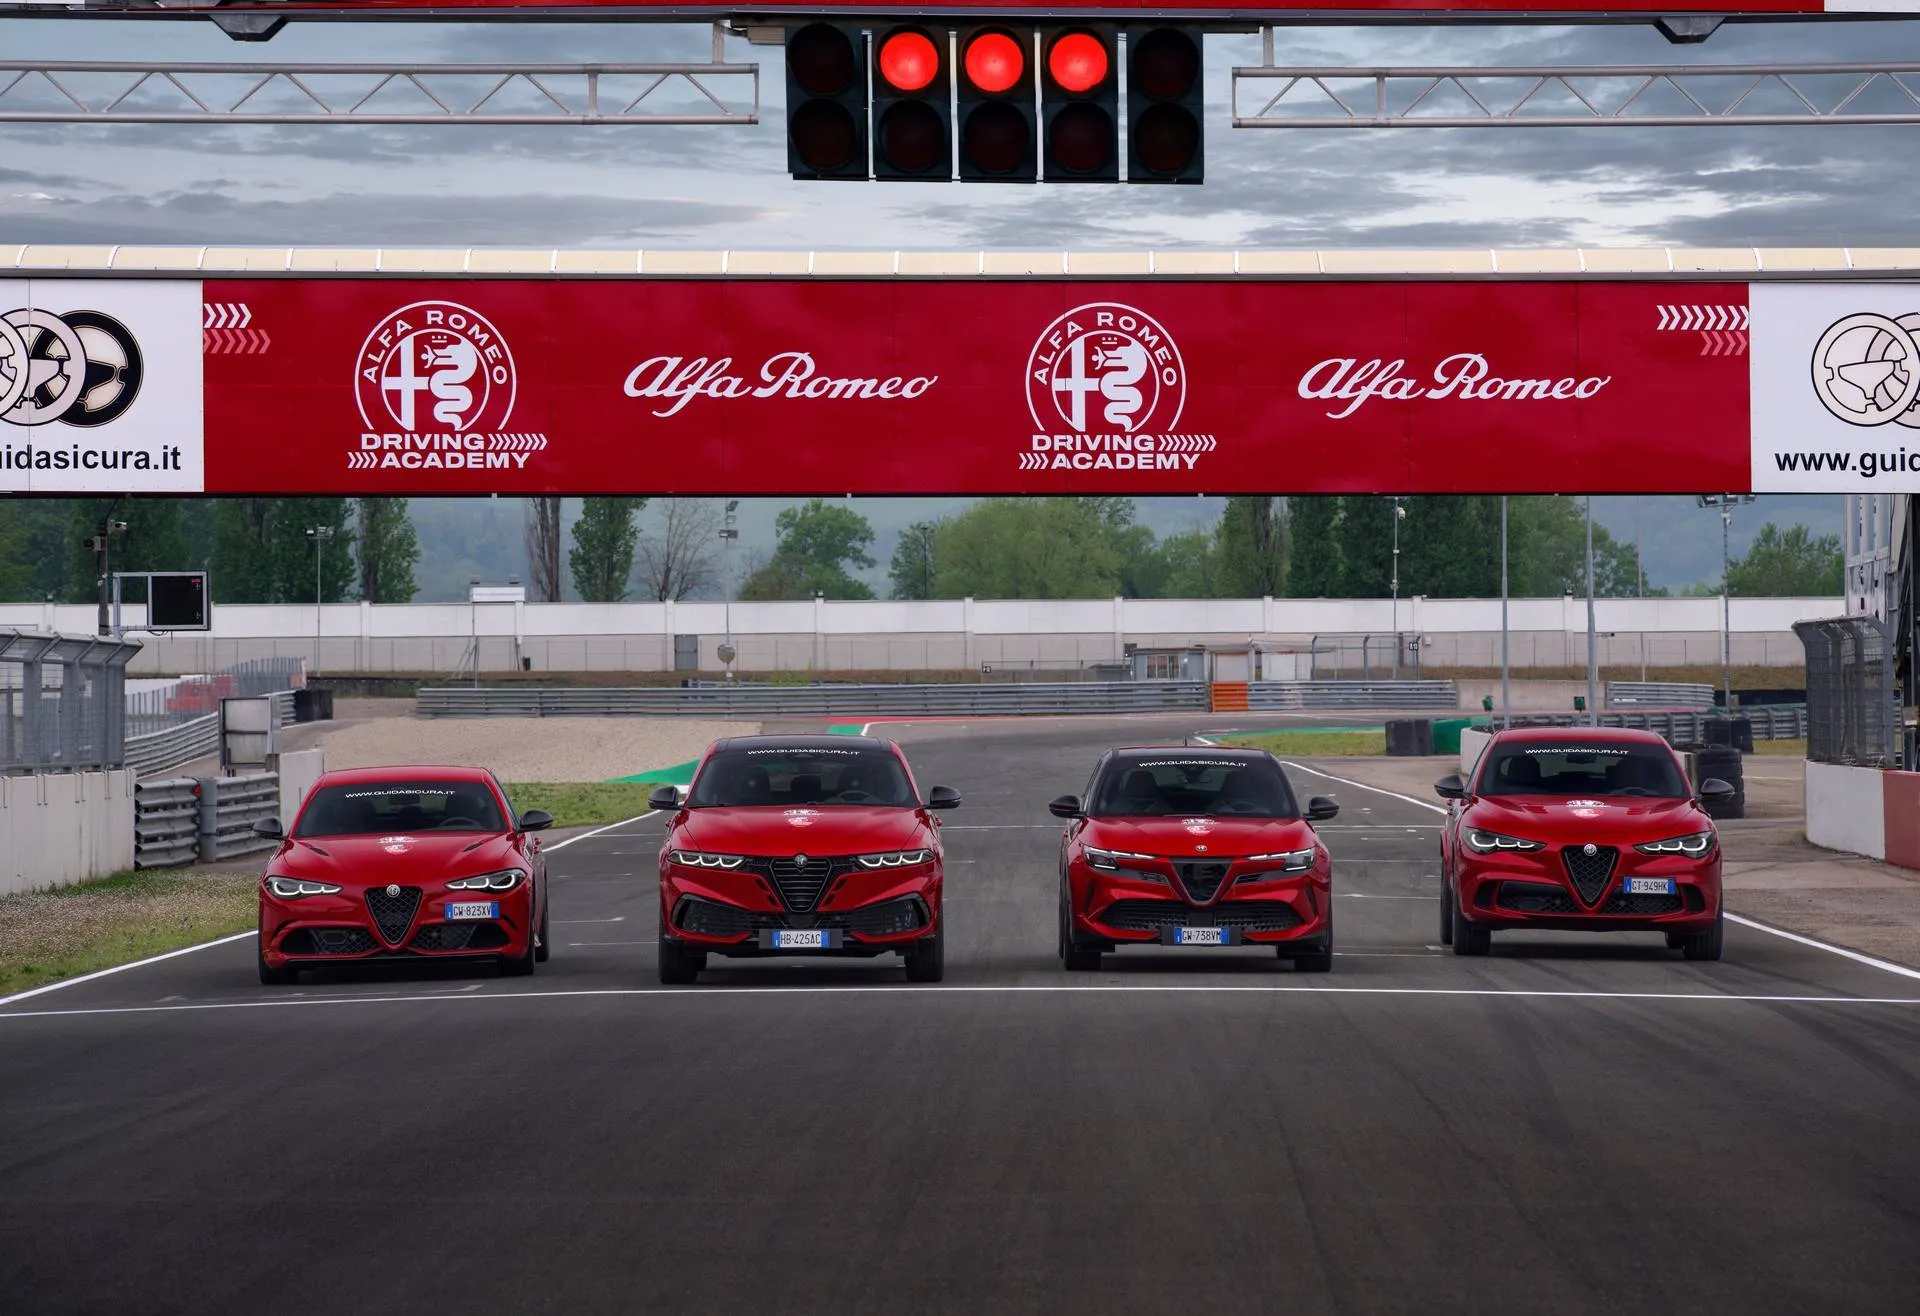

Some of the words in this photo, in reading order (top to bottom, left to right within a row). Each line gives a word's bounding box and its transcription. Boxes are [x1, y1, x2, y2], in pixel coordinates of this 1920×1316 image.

[363, 319, 413, 384] ALFA
[426, 310, 507, 385] ROMEO
[1034, 320, 1084, 385] ALFA
[1097, 311, 1177, 386] ROMEO
[623, 356, 752, 418] Alfa
[751, 351, 939, 399] Romeo
[1297, 358, 1426, 419] Alfa
[1425, 353, 1612, 400] Romeo
[361, 433, 485, 450] DRIVING
[1032, 434, 1155, 451] DRIVING
[0, 444, 181, 470] idasicura.it
[380, 452, 531, 469] ACADEMY
[1050, 453, 1201, 470] ACADEMY
[345, 789, 456, 798] WWW.GUIDASICURA.IT
